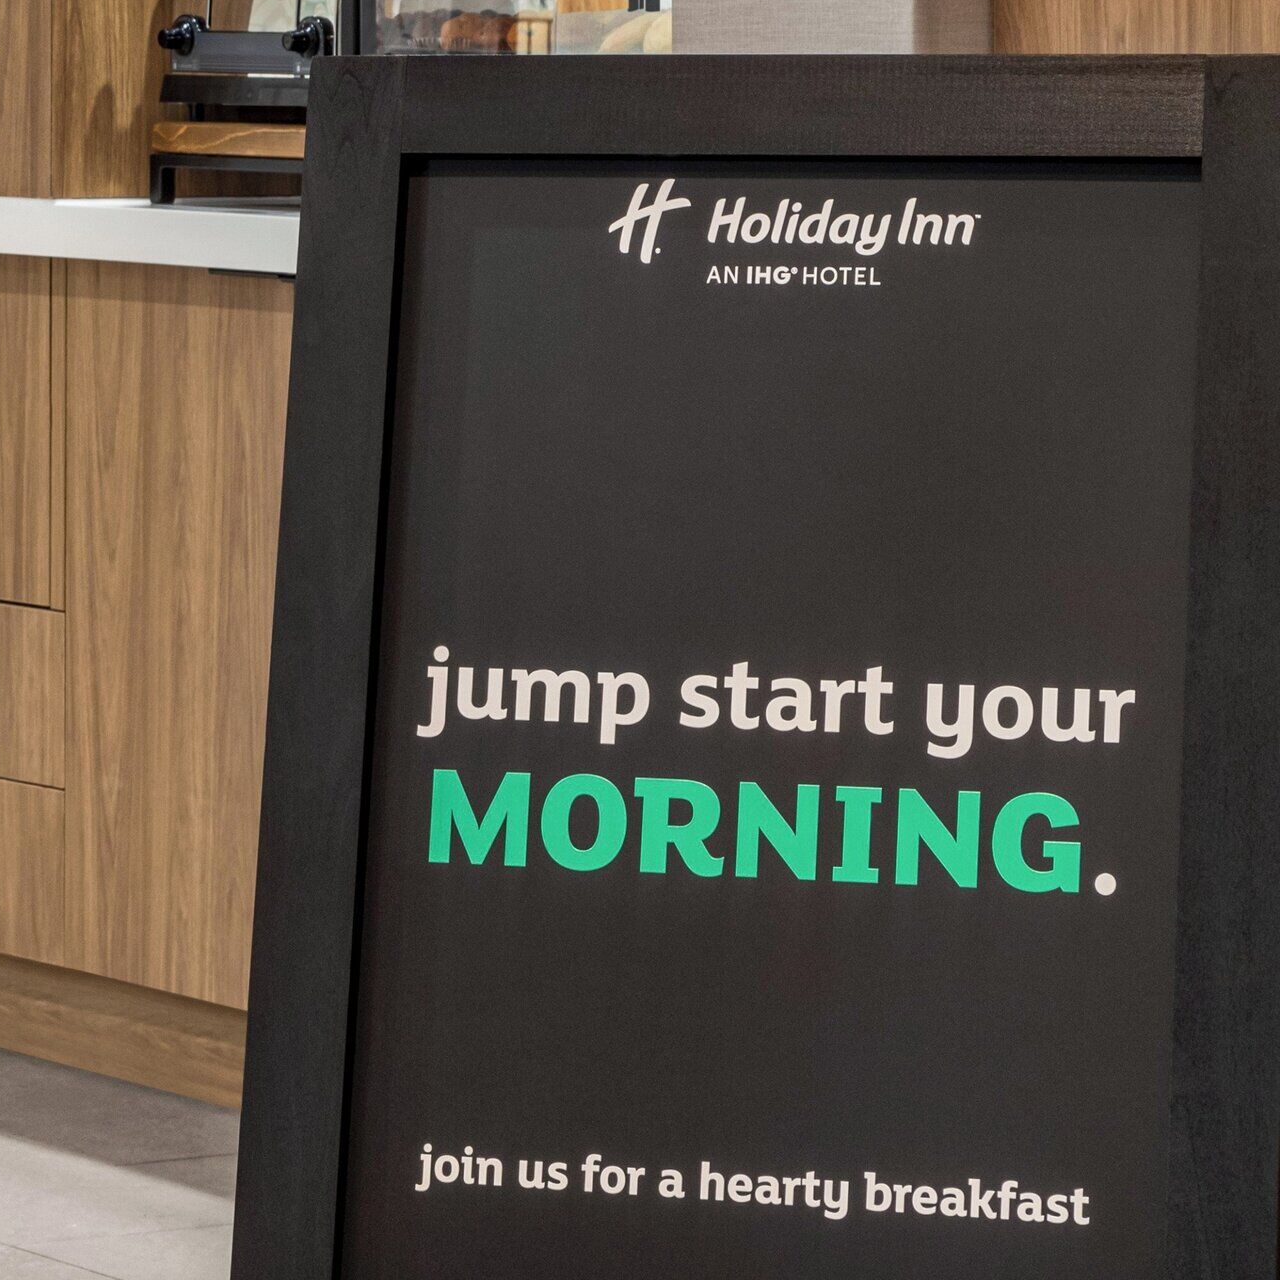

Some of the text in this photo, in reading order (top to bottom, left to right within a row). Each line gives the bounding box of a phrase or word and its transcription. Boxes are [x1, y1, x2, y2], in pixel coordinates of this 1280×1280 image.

[706, 196, 893, 257] Holiday
[705, 265, 740, 285] AN
[802, 266, 882, 286] HOTEL
[415, 644, 1137, 760] jump start your
[428, 768, 1117, 897] MORNING.
[414, 1142, 1091, 1226] join us for a hearty breakfast
